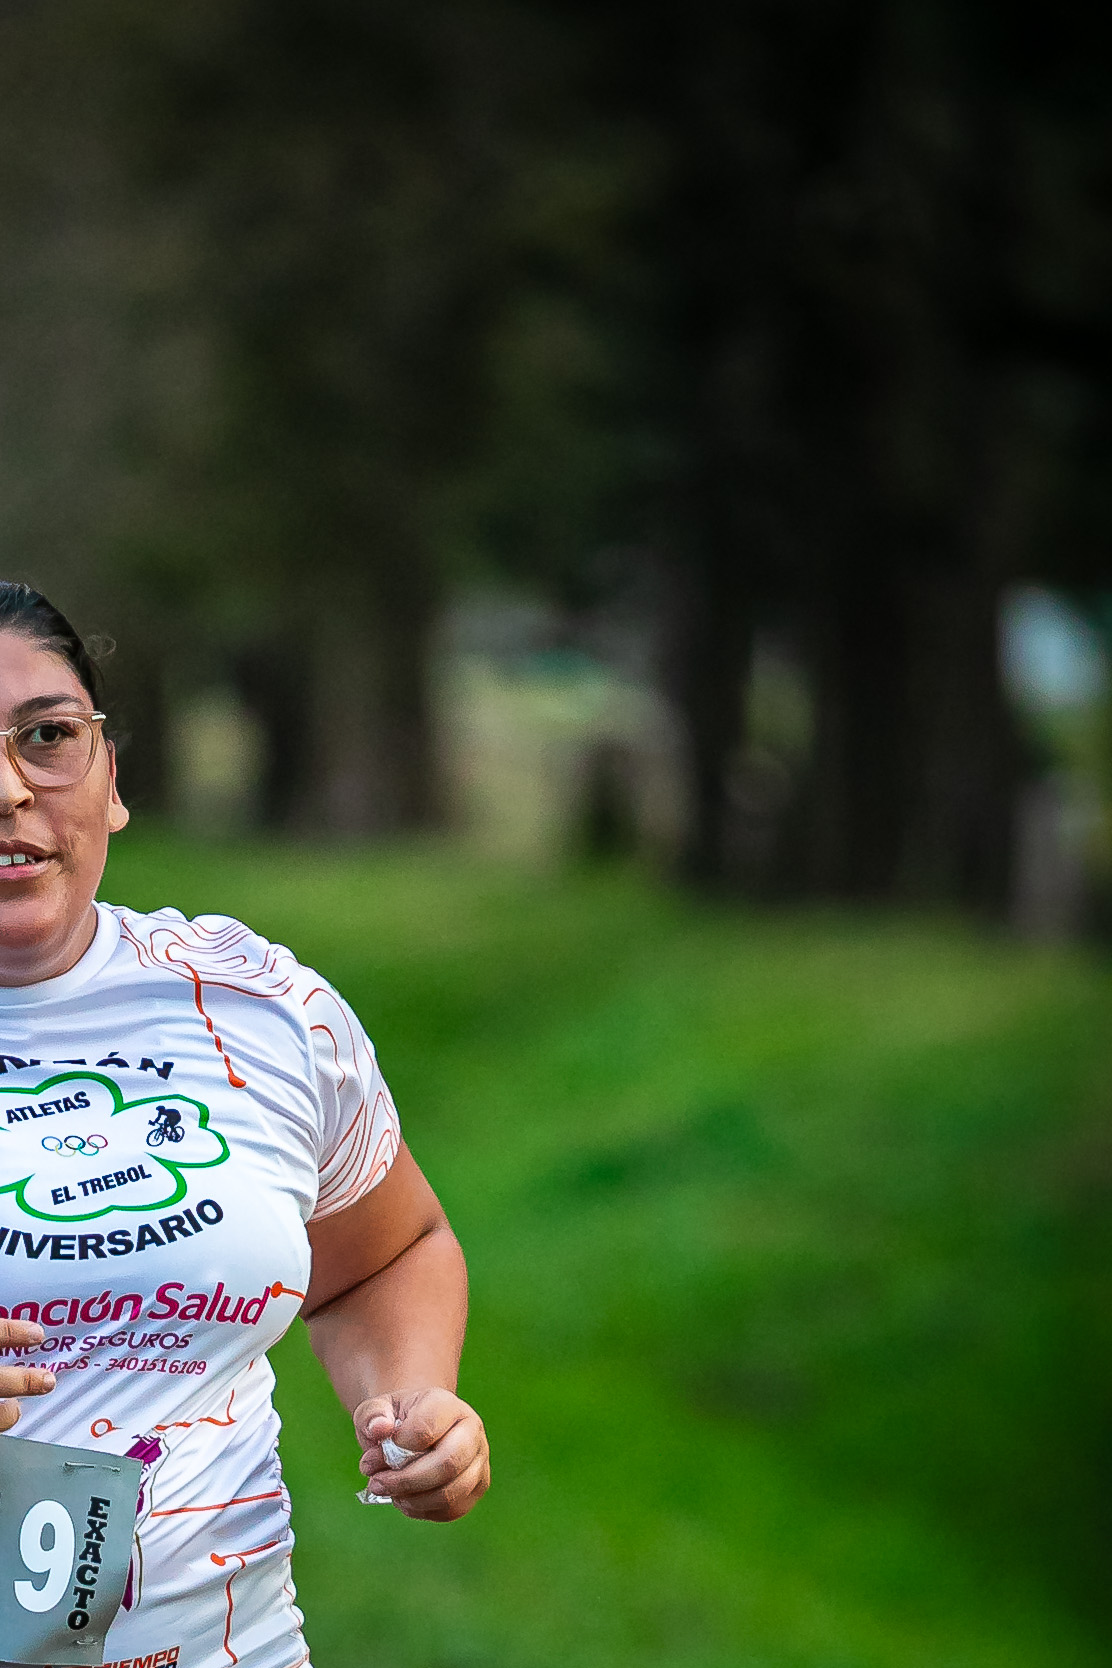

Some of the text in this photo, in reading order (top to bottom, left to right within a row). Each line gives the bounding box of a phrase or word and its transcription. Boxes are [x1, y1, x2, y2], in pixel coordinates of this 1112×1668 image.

[5, 1091, 91, 1124] ATLETAS
[51, 1164, 152, 1206] EL TREBOL
[147, 1282, 272, 1326] Salud
[79, 1331, 194, 1352] SEGUROS
[67, 1496, 111, 1631] EXACTO
